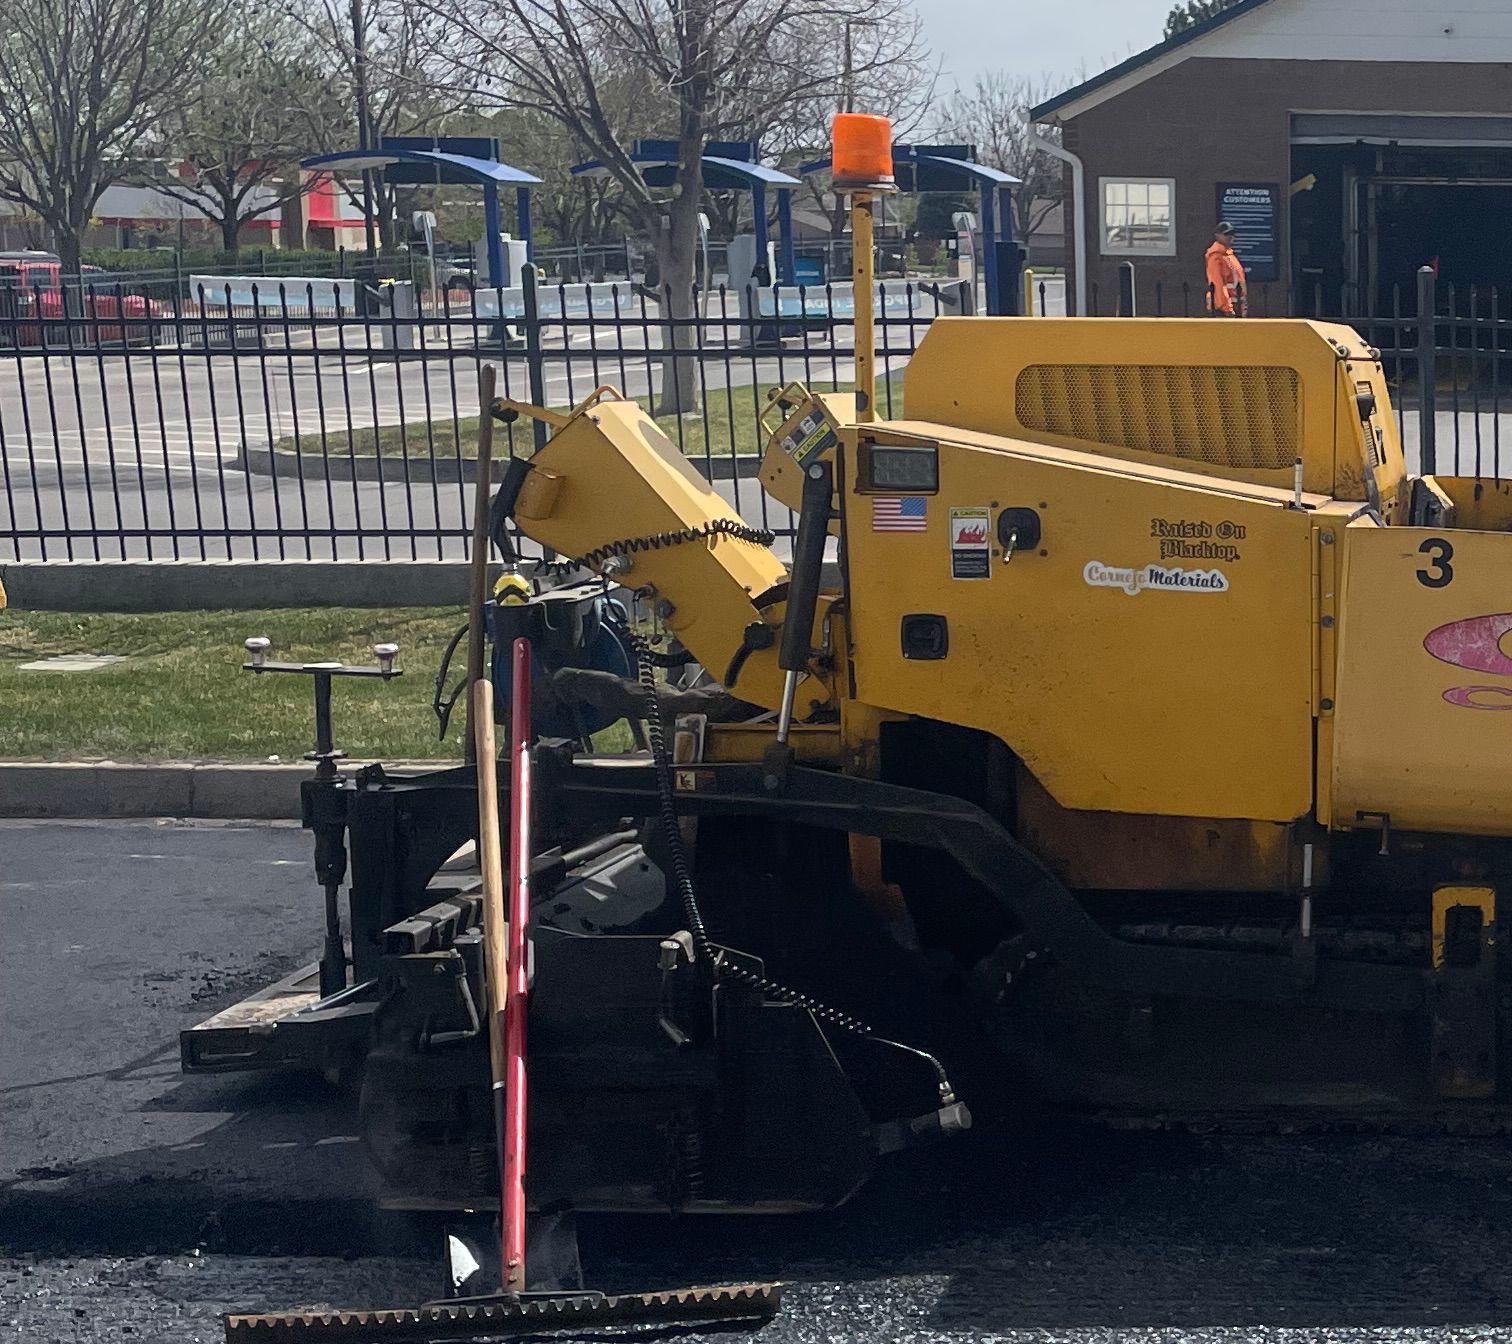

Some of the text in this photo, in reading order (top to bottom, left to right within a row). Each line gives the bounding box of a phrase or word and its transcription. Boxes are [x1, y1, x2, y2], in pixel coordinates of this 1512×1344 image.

[1151, 518, 1247, 539] Raised On
[1416, 537, 1455, 588] 3
[1087, 565, 1225, 591] Cornejo Materials
